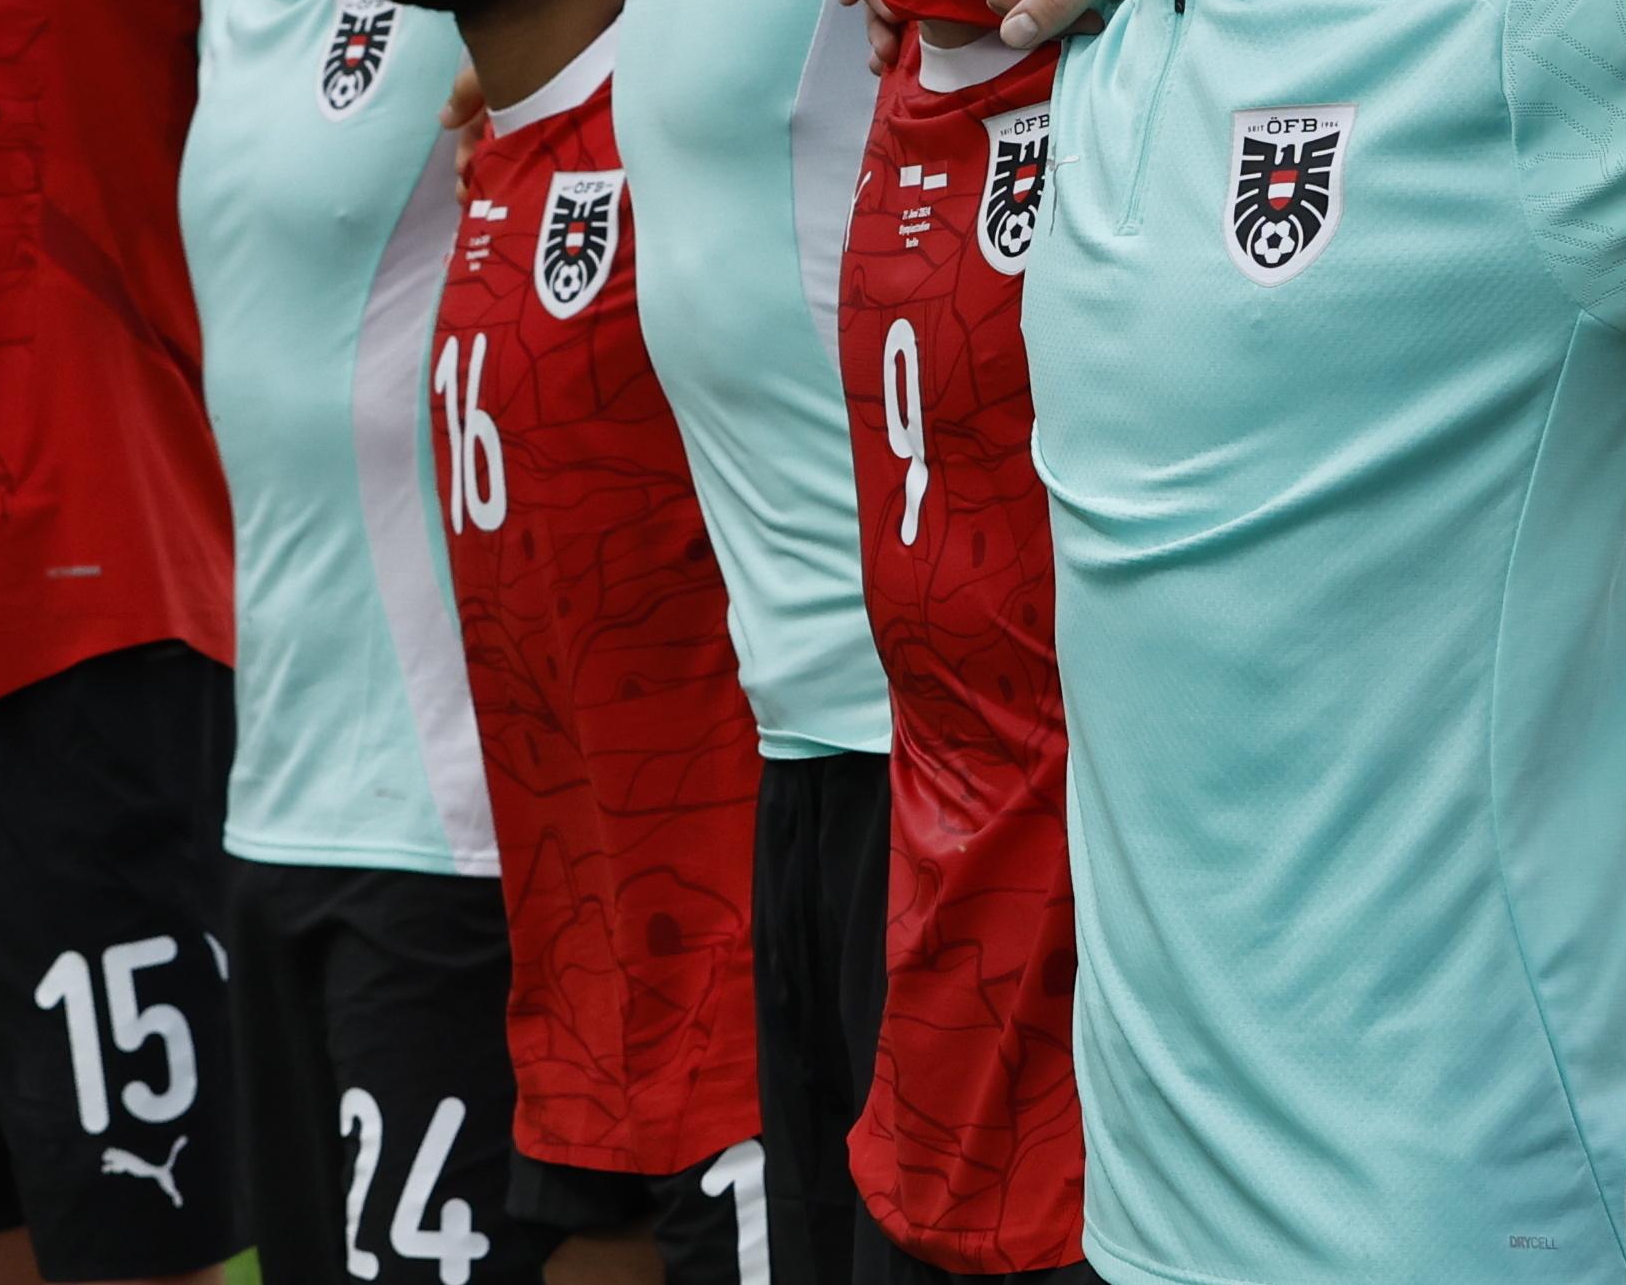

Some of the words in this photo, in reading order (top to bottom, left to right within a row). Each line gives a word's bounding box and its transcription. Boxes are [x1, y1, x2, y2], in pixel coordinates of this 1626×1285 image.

[1014, 113, 1050, 135] ÖFB
[1247, 125, 1265, 133] SEIT
[1266, 116, 1318, 135] ÖFB
[433, 332, 507, 535] 16
[882, 317, 929, 547] 9
[34, 936, 197, 1134] 15
[339, 1086, 490, 1285] 24
[1509, 1235, 1559, 1250] DRYCELL
